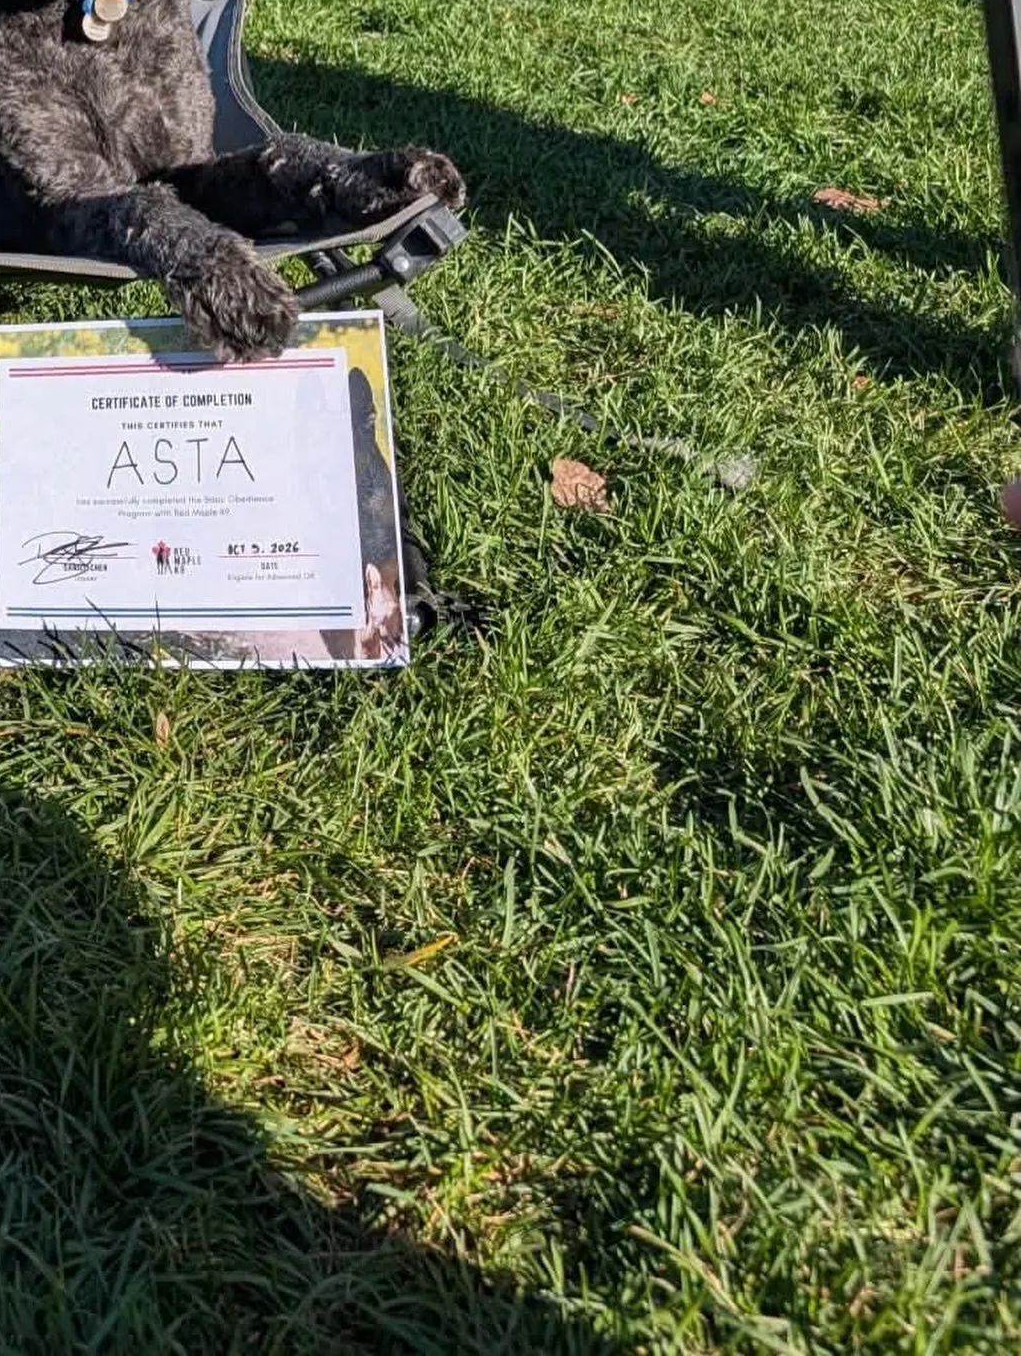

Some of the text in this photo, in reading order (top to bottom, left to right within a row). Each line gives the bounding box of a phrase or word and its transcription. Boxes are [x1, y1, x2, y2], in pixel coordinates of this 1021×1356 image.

[91, 393, 252, 410] CERTIFICATE OF COMPLETION
[121, 419, 223, 430] THIS CERTIFIES THAT
[107, 435, 255, 488] ASTA
[270, 541, 299, 554] 2026
